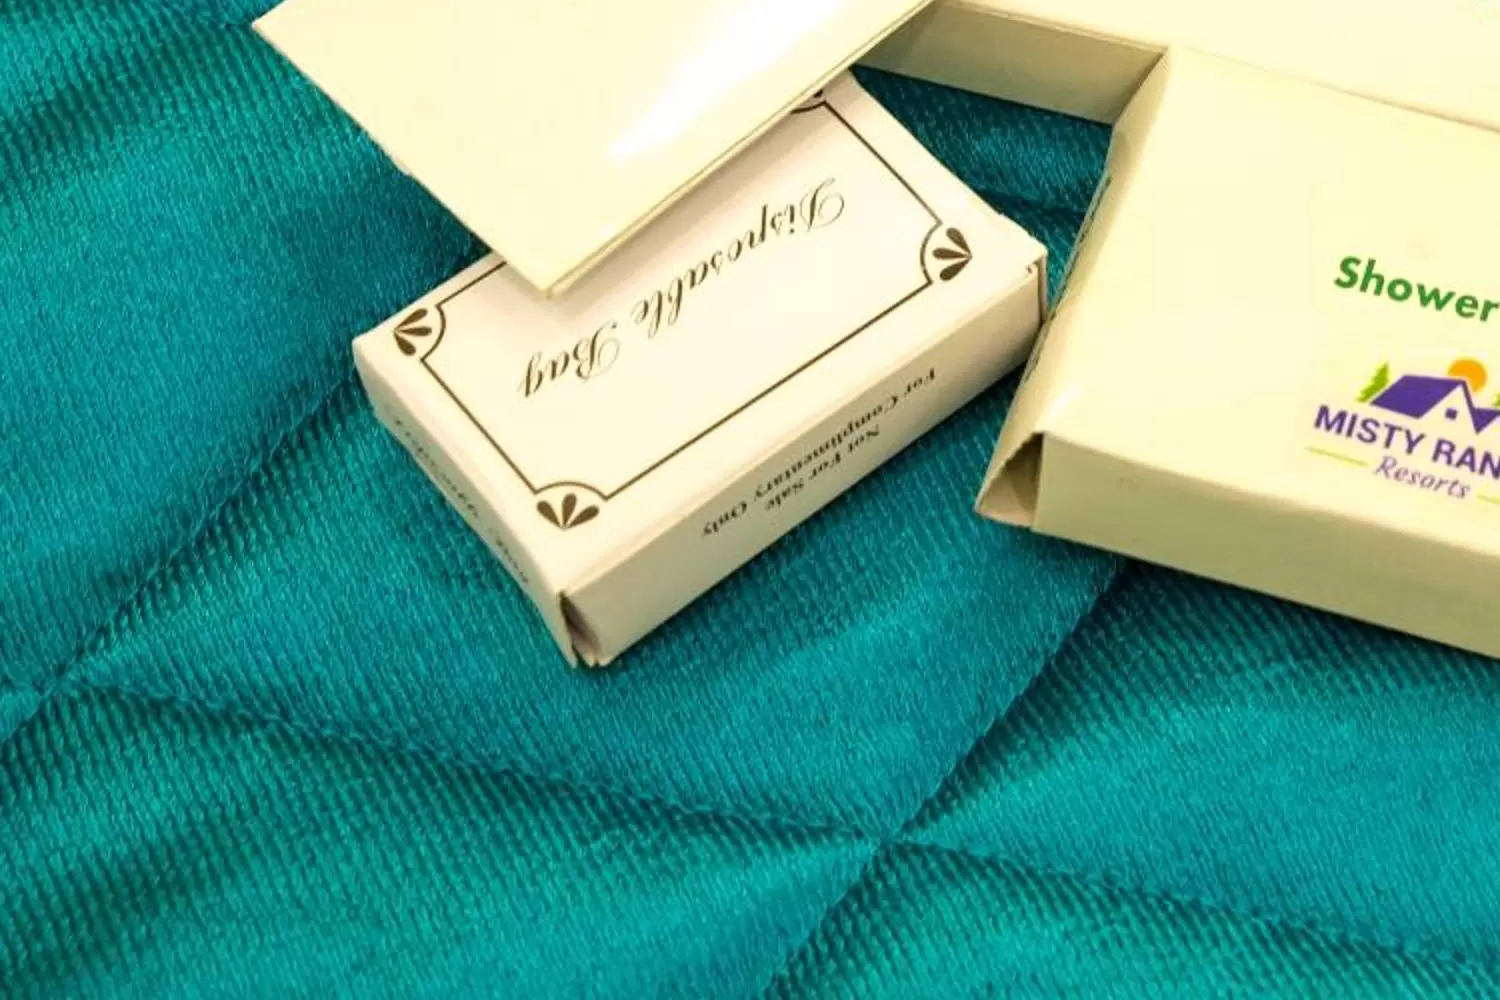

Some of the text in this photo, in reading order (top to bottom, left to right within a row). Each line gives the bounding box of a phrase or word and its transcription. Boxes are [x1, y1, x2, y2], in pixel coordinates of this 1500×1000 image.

[517, 177, 845, 398] Disposable Bag
[1333, 255, 1500, 322] Shower
[702, 368, 935, 537] For Complimentary Only
[765, 424, 880, 510] Not For Sale
[1314, 404, 1426, 456] MISTY
[1373, 455, 1471, 499] Resorts
